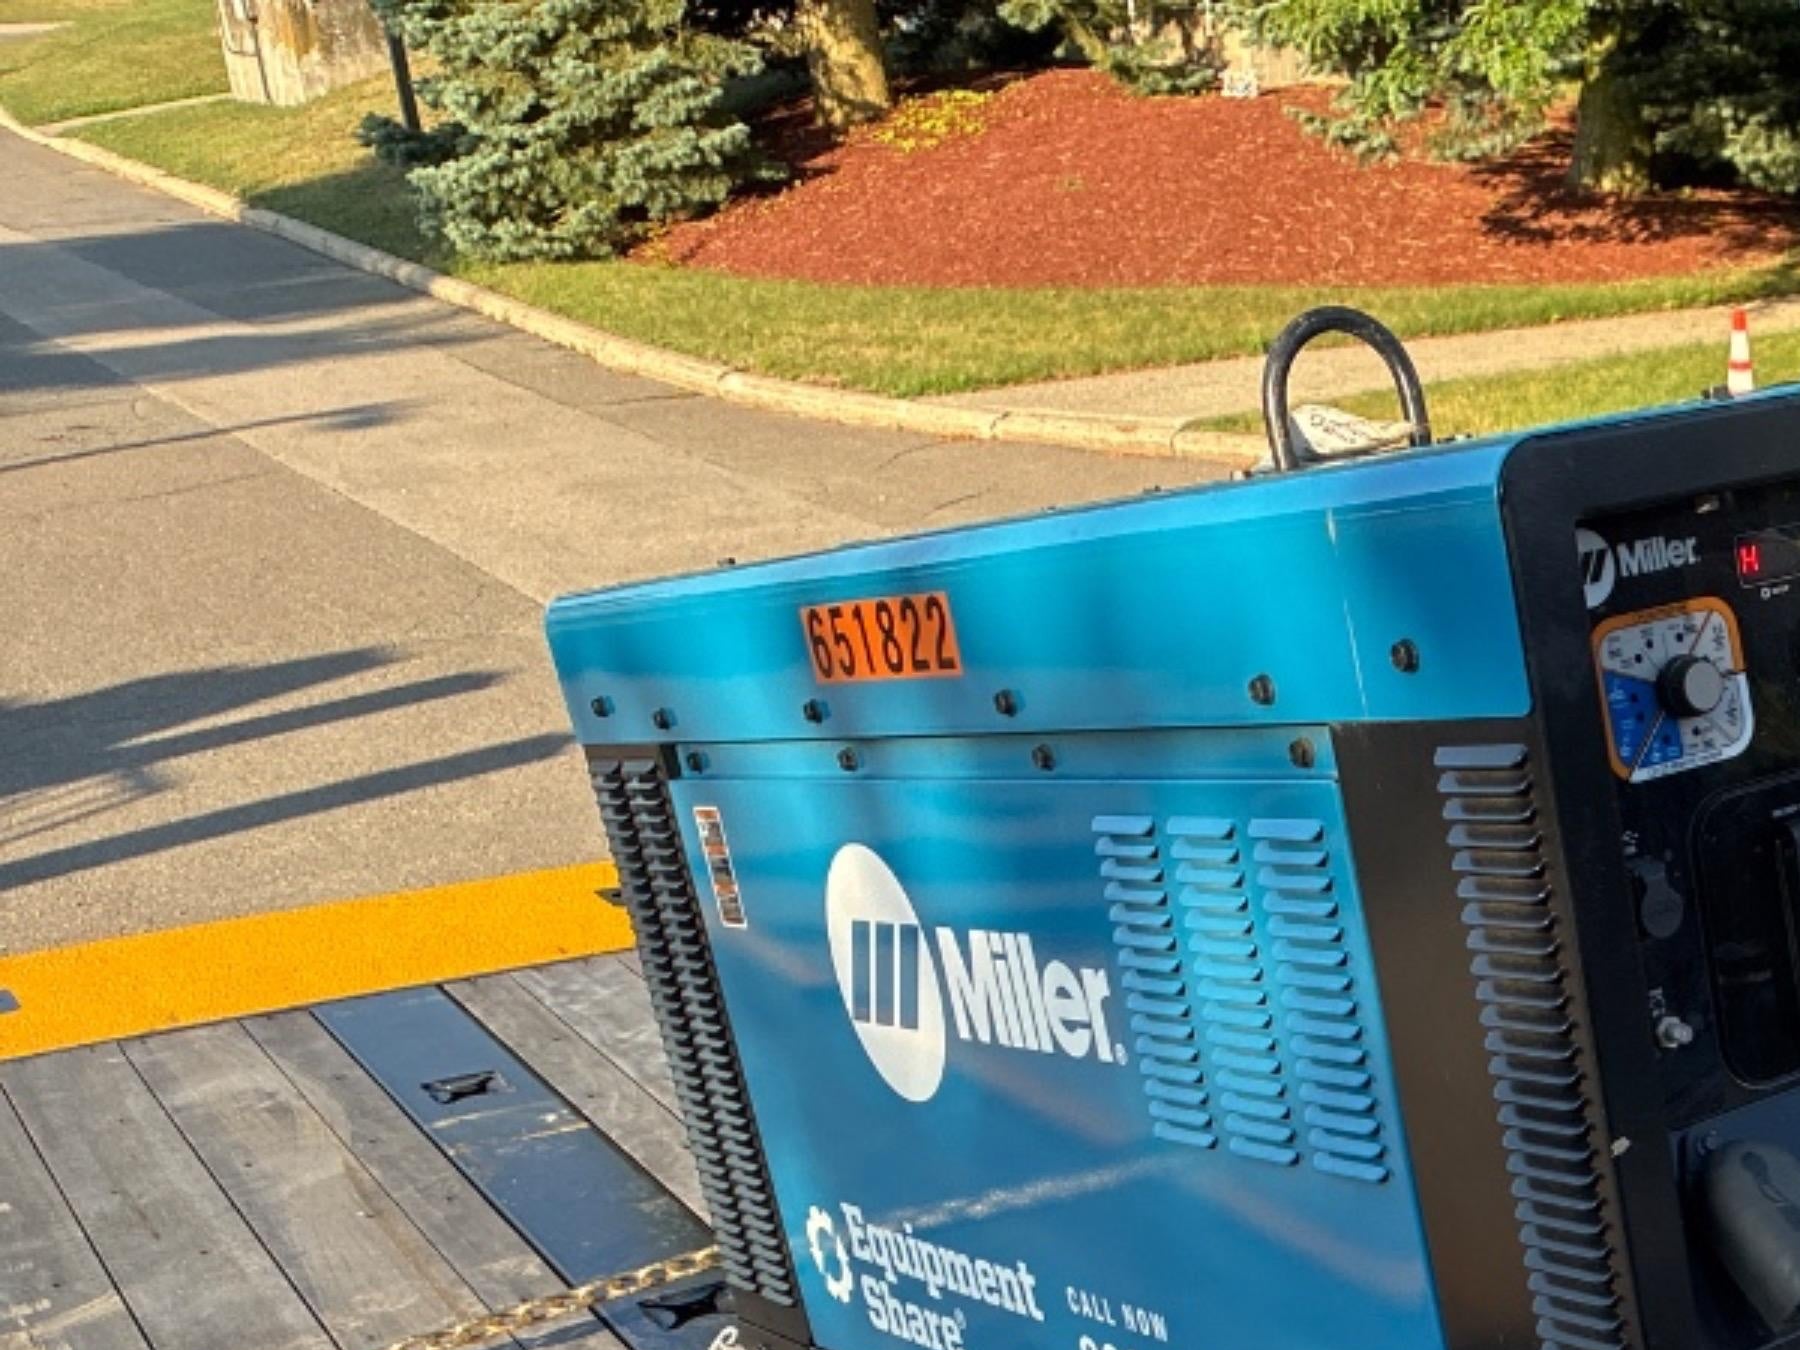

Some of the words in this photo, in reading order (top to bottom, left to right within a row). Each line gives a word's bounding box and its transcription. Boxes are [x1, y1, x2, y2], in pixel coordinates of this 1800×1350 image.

[1616, 536, 1698, 578] Miller
[807, 596, 957, 679] 651822
[935, 926, 1118, 1065] Miller
[840, 1202, 1046, 1323] Equipment
[1065, 1286, 1118, 1327] CALL
[1121, 1302, 1169, 1343] NOW
